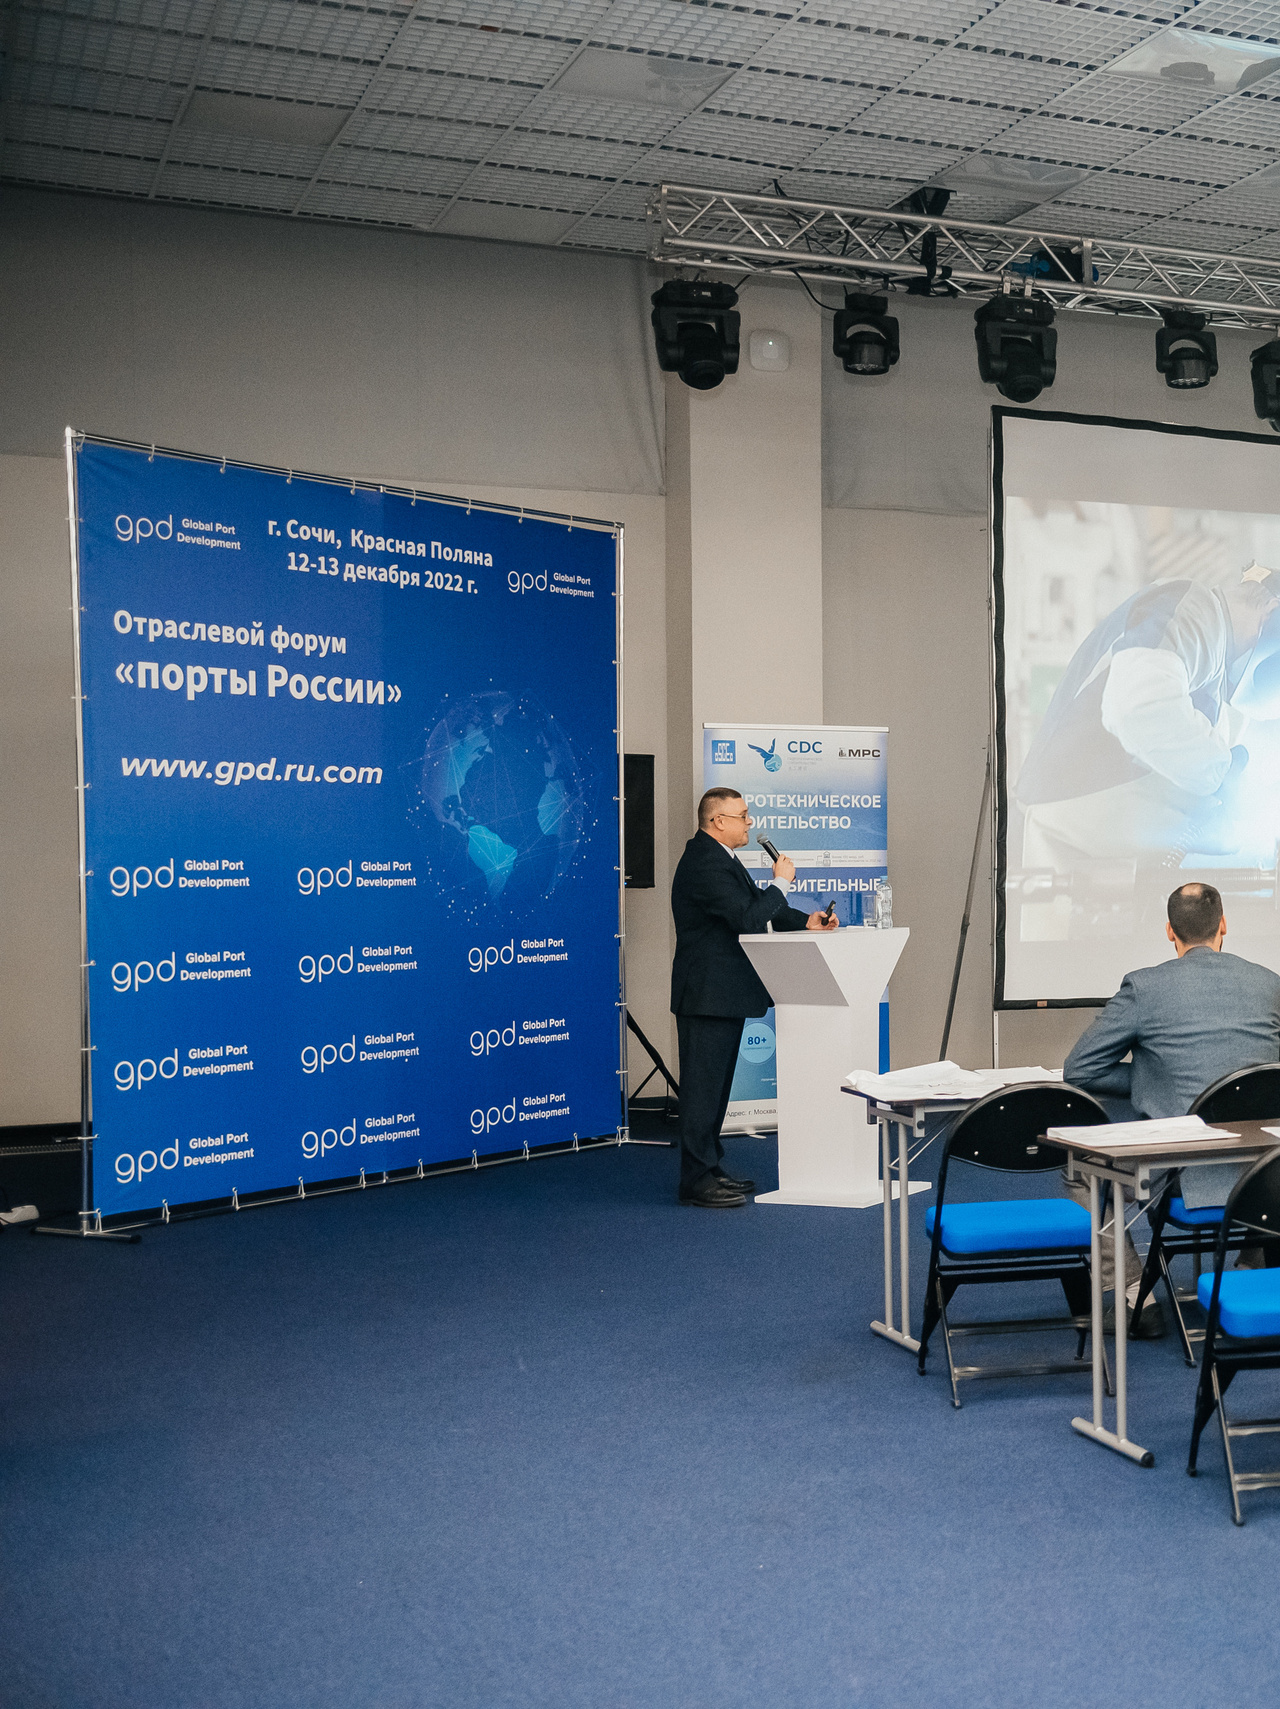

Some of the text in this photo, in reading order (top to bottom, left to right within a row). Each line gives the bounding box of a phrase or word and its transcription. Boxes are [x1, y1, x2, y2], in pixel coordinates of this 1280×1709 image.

[115, 514, 173, 544] gpd
[182, 518, 235, 535] Global Port
[177, 532, 241, 550] Development
[268, 519, 493, 567] г. Сочи, Красная Поляна
[288, 552, 478, 594] 12-13 декабря 2022 г.
[553, 572, 591, 585] Global Port
[508, 570, 547, 594] gpd
[550, 584, 594, 598] Development
[114, 610, 346, 658] Отраслевой форум
[116, 661, 401, 705] «порты России»
[788, 741, 822, 753] CDC
[121, 757, 383, 785] www.gpd.ru.com
[742, 794, 881, 808] РОТЕХНИЧЕСКОЕ
[749, 816, 851, 829] ОИТЕЛЬСТВО
[184, 860, 244, 871] Global Port
[361, 861, 411, 871] Global Port
[110, 858, 174, 897] gpd
[179, 876, 250, 889] Development
[297, 860, 352, 895] gpd
[356, 877, 416, 888] Development
[362, 945, 412, 957] Global Port
[521, 938, 564, 949] Global Port
[186, 951, 245, 964] Global Port
[468, 938, 514, 973] gpd
[517, 952, 568, 963] Development
[111, 951, 175, 992] gpd
[299, 946, 353, 983] gpd
[357, 961, 417, 973] Development
[180, 967, 251, 981] Development
[522, 1018, 565, 1030] Global Port
[364, 1032, 414, 1045] Global Port
[470, 1021, 515, 1056] gpd
[519, 1032, 569, 1045] Development
[747, 1036, 767, 1045] 80+
[188, 1045, 248, 1059] Global Port
[301, 1035, 355, 1074] gpd
[360, 1047, 419, 1062] Development
[114, 1048, 178, 1091] gpd
[183, 1061, 254, 1077] Development
[523, 1093, 565, 1106] Global Port
[365, 1113, 415, 1128] Global Port
[470, 1097, 516, 1134] gpd
[519, 1107, 570, 1121] Development
[189, 1132, 248, 1149] Global Port
[302, 1118, 356, 1159] gpd
[360, 1128, 420, 1144] Development
[115, 1139, 179, 1183] gpd
[184, 1148, 254, 1167] Development
